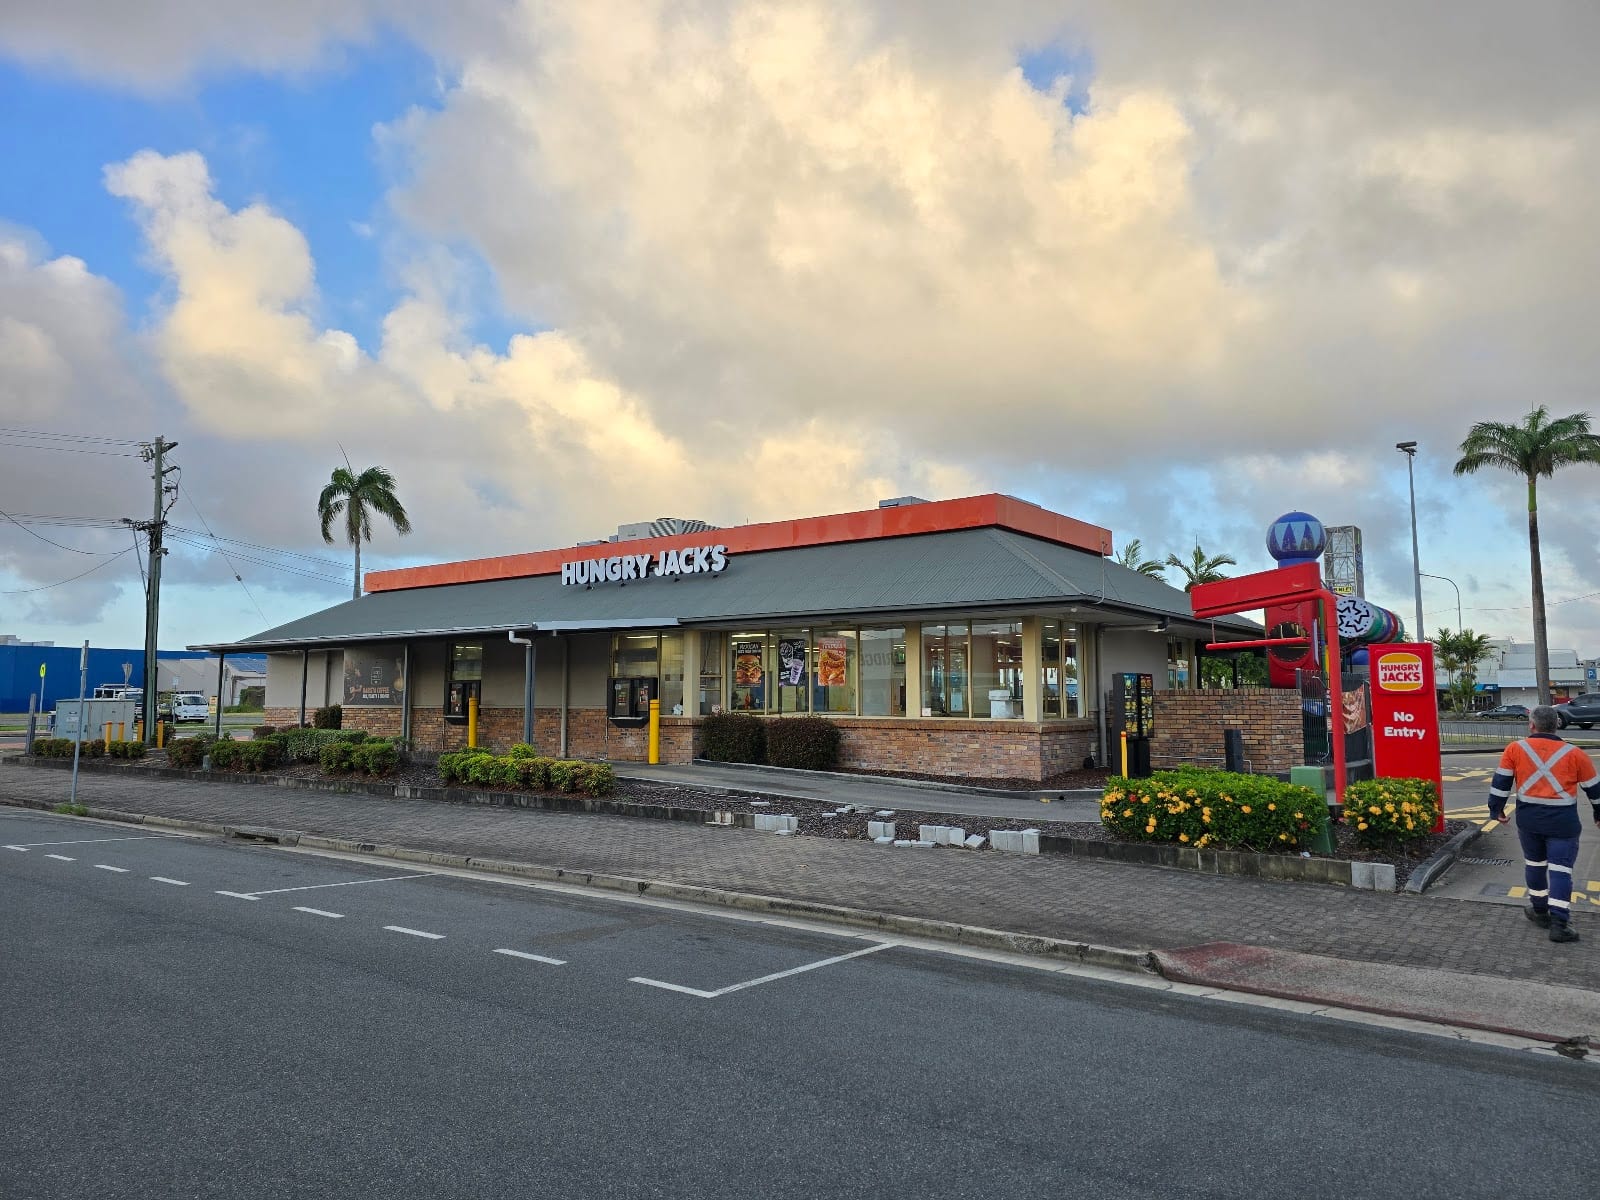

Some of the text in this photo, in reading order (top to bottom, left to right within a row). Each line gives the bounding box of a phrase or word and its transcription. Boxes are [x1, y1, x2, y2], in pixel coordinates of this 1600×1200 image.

[561, 544, 728, 586] HUNGRY JACK'S
[1380, 663, 1420, 672] HUNGRY
[1381, 672, 1421, 682] JACK'S
[1393, 711, 1415, 722] No
[1383, 726, 1426, 740] Entry
